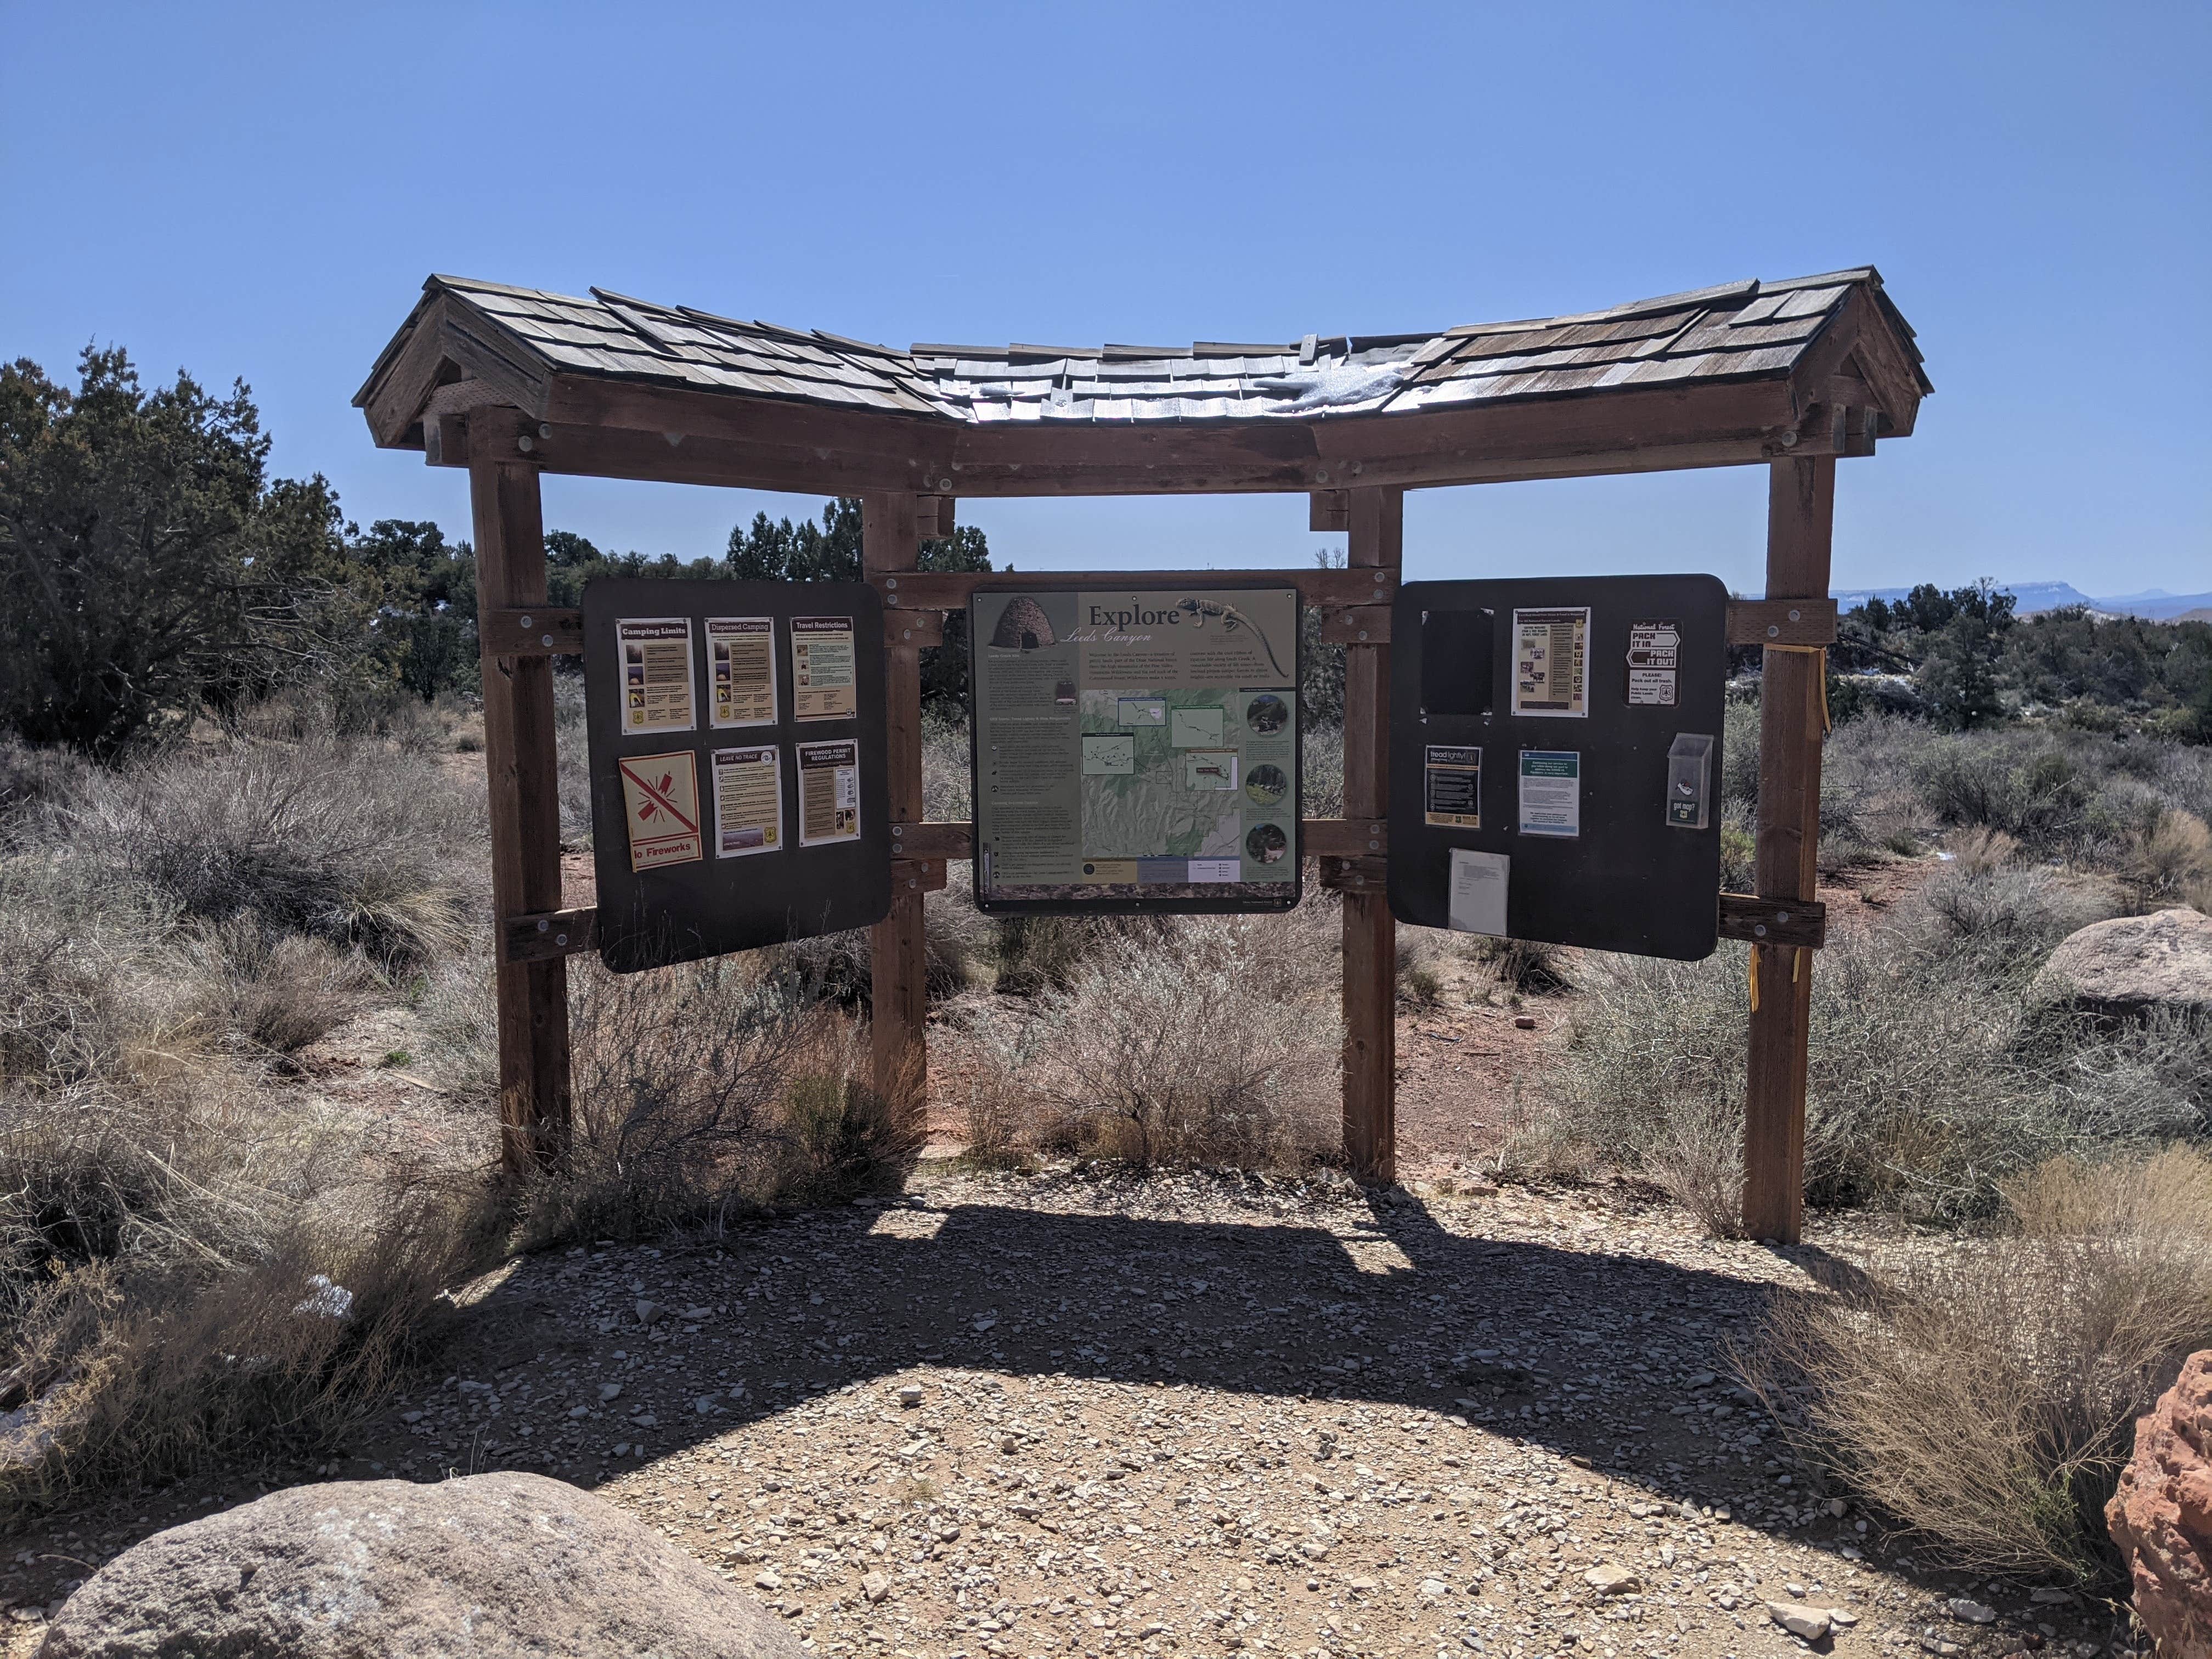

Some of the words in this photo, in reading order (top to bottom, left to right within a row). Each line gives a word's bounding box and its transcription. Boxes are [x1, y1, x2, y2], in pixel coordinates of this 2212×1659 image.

[1088, 604, 1180, 631] Explore
[623, 628, 659, 636] Camping
[1060, 627, 1097, 642] Leeds
[1101, 627, 1152, 646] Canyon
[1683, 803, 1695, 812] map?
[646, 843, 691, 856] Fireworks
